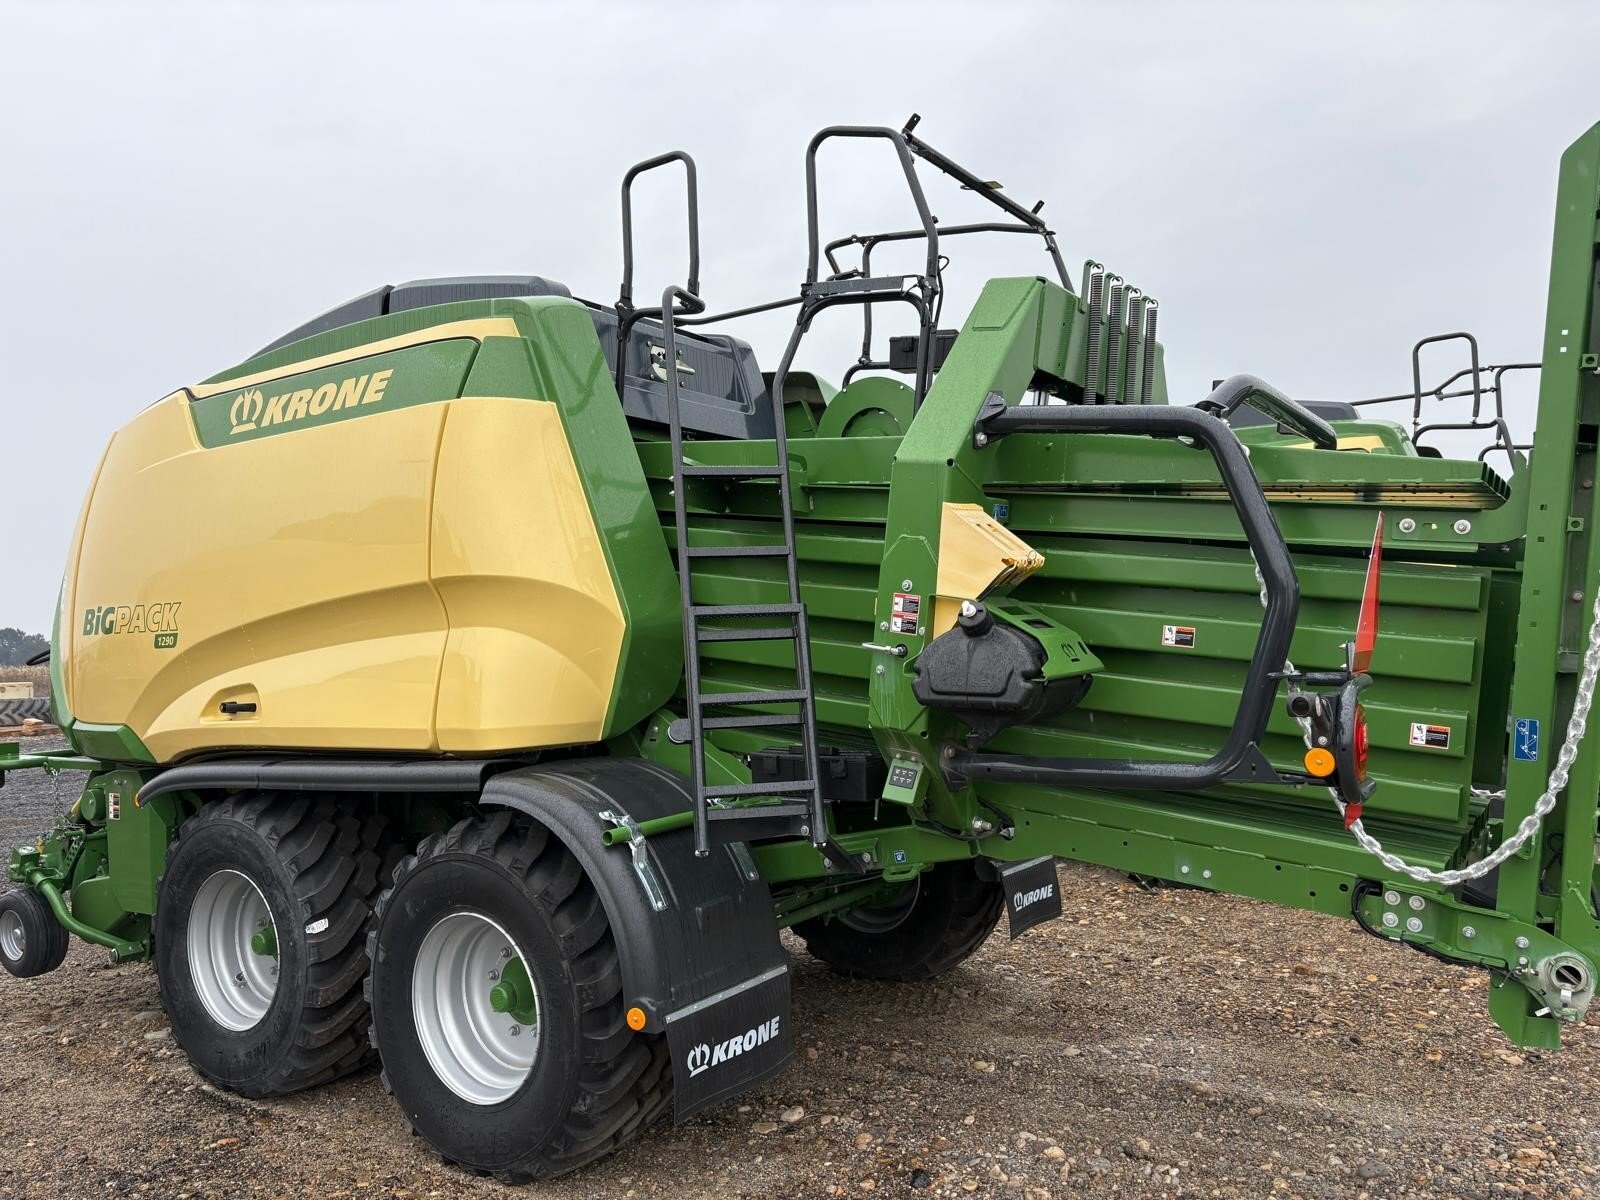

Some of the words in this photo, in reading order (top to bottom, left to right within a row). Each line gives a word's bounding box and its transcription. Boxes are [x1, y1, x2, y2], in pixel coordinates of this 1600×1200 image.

[260, 368, 394, 428] KRONE
[157, 636, 175, 646] 1290
[1022, 883, 1053, 908] KRONE
[711, 1015, 780, 1067] KRONE
